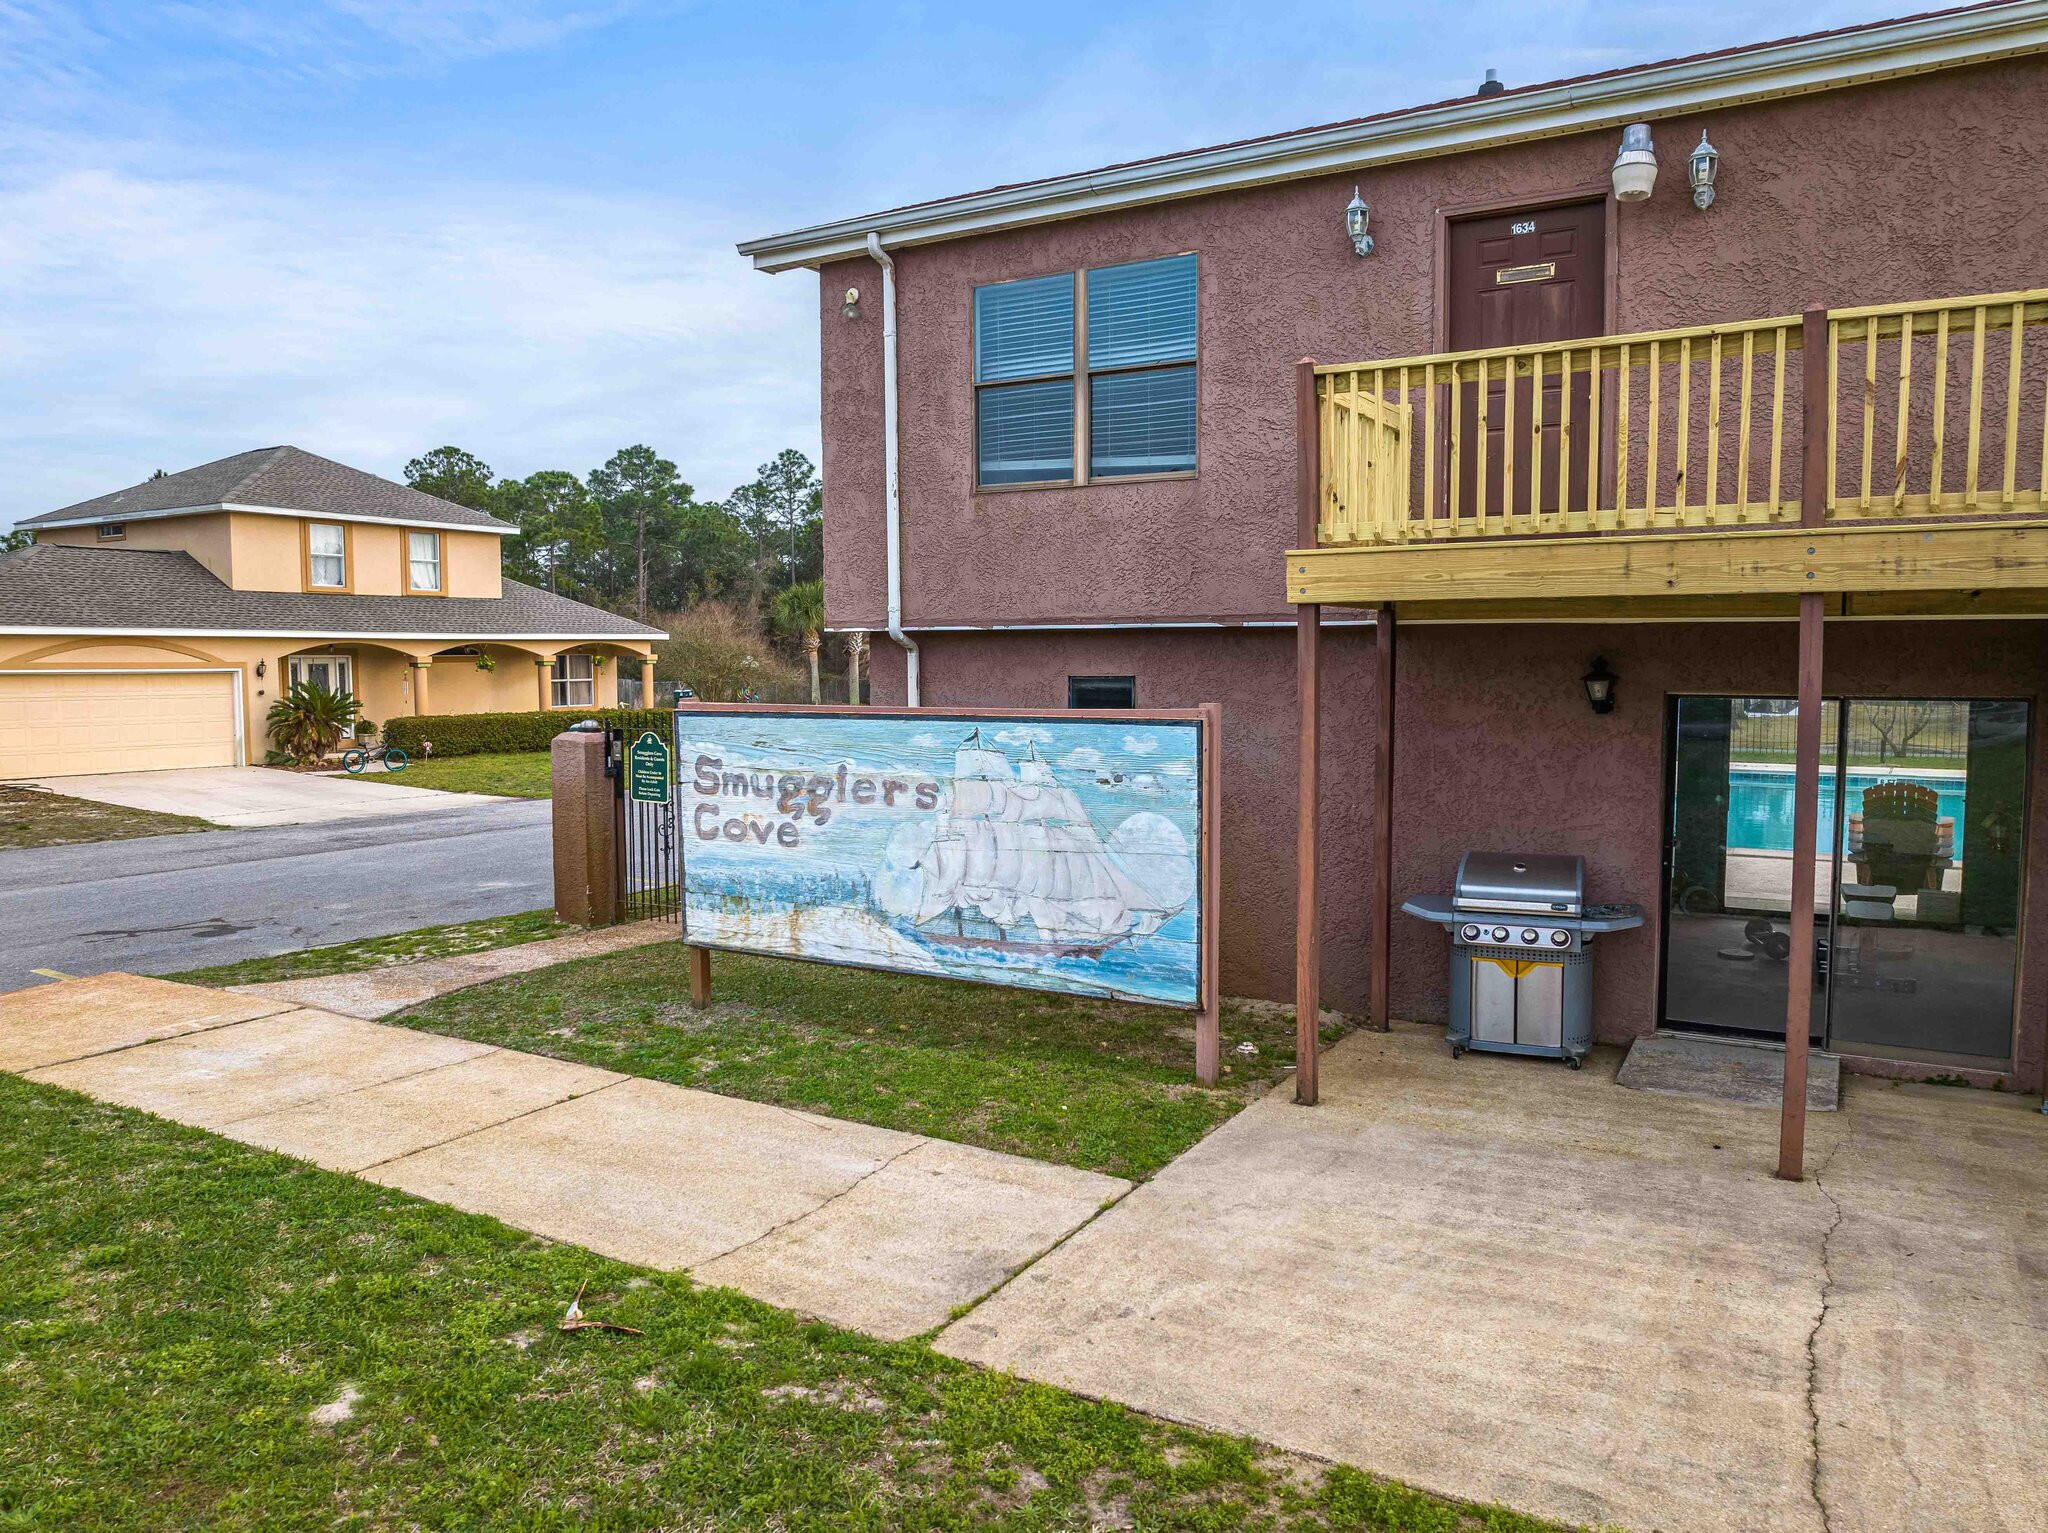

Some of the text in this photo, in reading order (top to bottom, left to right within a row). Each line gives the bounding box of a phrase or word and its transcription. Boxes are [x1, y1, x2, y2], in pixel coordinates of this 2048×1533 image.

[1511, 221, 1536, 235] 1634
[693, 754, 940, 826] Smugglers
[694, 802, 800, 848] Cove
